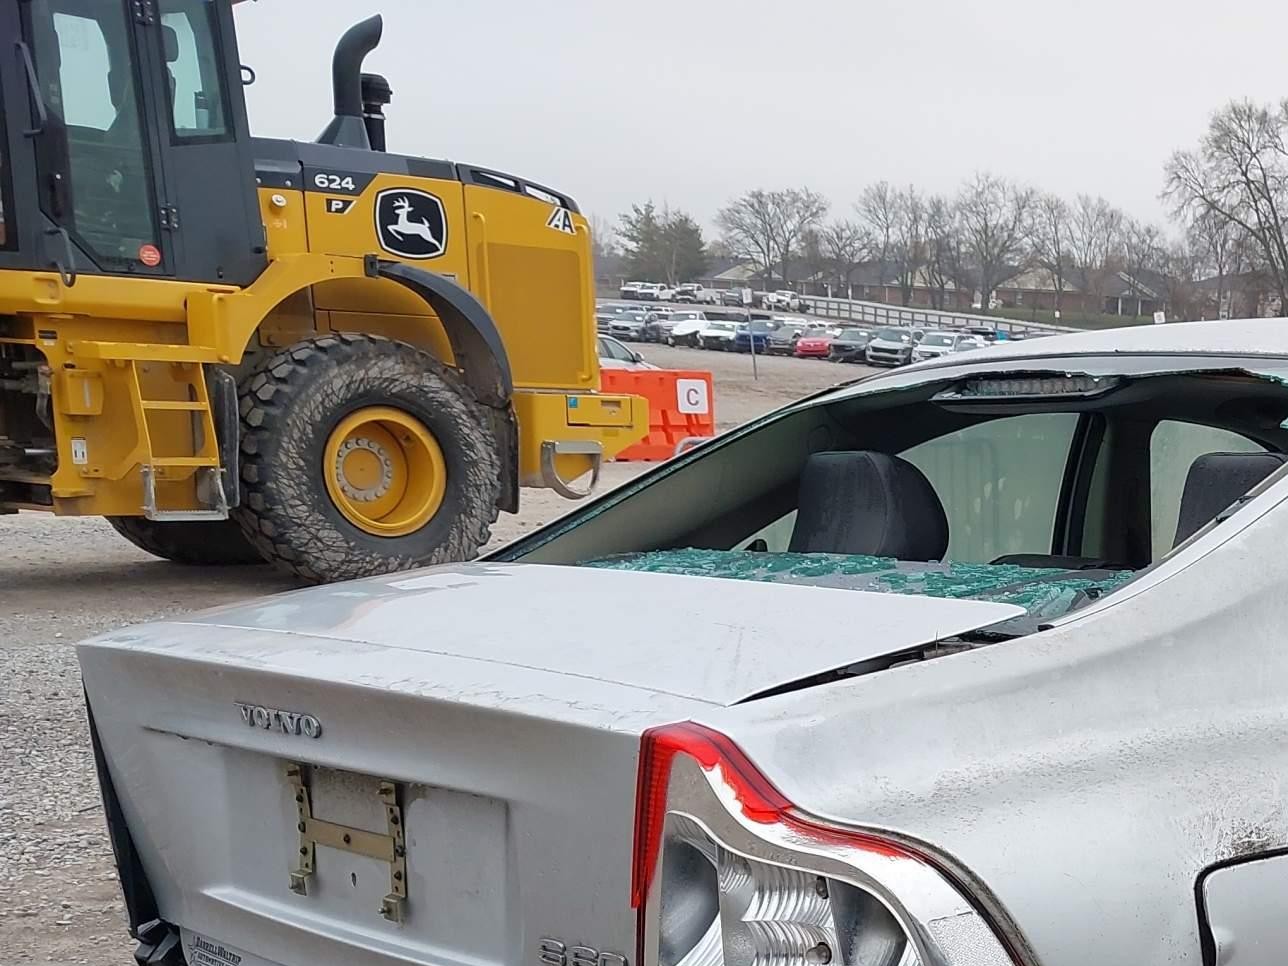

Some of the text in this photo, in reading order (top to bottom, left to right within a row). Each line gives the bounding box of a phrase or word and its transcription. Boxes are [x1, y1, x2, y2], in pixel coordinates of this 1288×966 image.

[314, 173, 355, 191] 624
[331, 200, 344, 212] P
[686, 388, 699, 406] C
[234, 701, 322, 739] VOLVO
